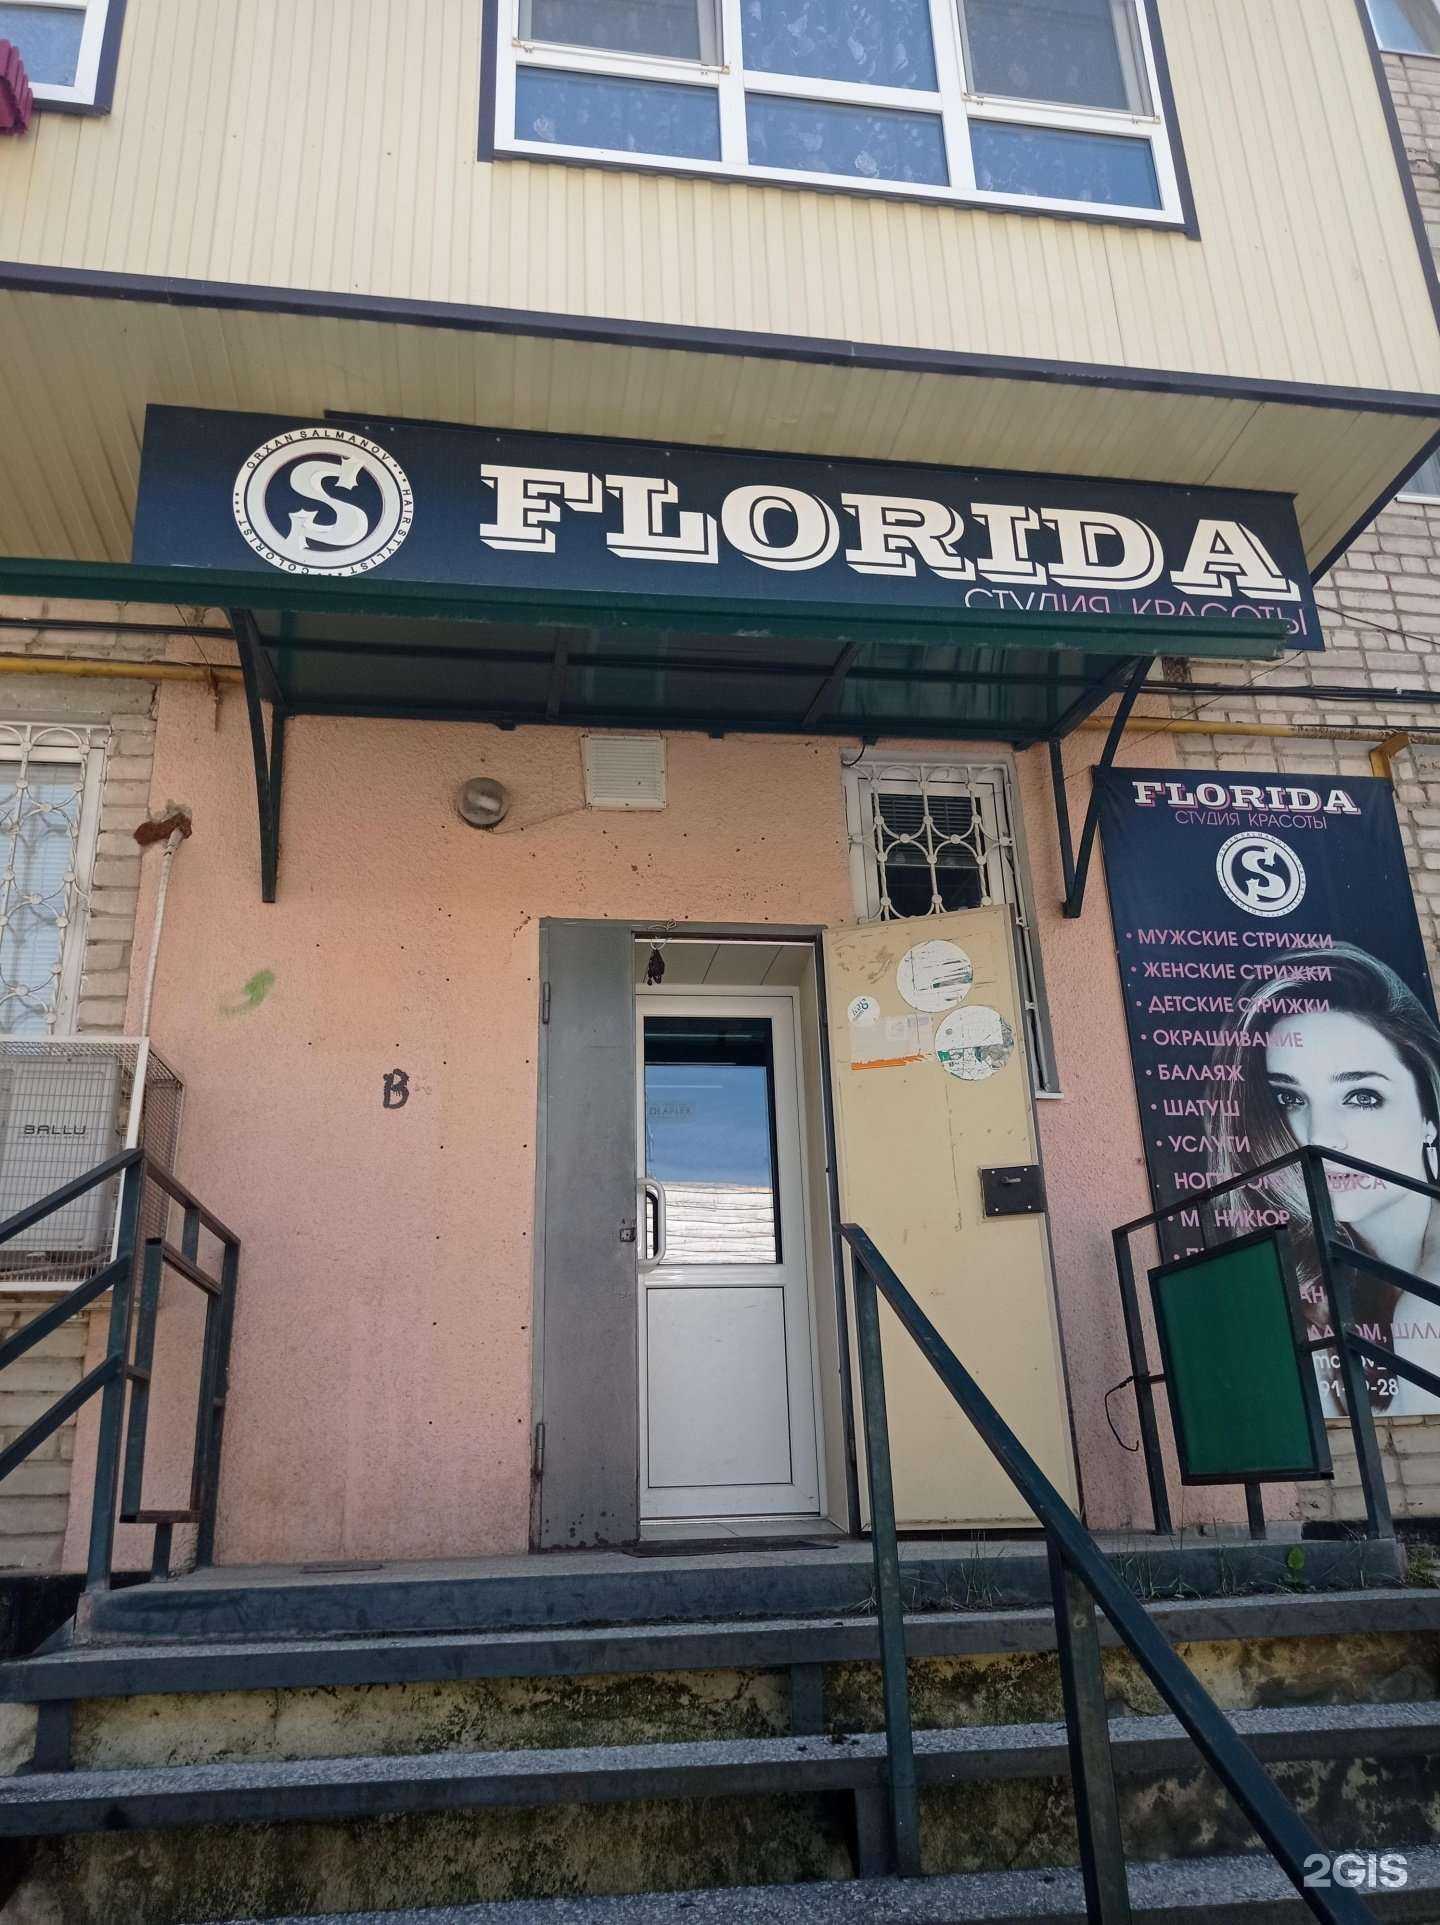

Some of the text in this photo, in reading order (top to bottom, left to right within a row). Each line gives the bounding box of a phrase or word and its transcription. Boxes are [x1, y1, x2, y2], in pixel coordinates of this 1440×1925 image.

[246, 429, 391, 469] ORXAN SALMANOV
[349, 488, 413, 574] HAIRSTYLIST
[479, 464, 1302, 602] FLORIDA
[238, 518, 310, 575] COLORIST
[1132, 780, 1362, 815] FLORIDA
[1175, 810, 1328, 830] СТУДИЯ КРАСОТЫ
[1138, 929, 1333, 949] МУЖСКИЕ СТРИЖКИ
[1143, 962, 1332, 982] ЖЕНСКИЕ СТРИЖКИ
[1148, 995, 1330, 1014] ДЕТСКИЕ СТРИЖКИ
[1153, 1029, 1304, 1047] ОКРАШИВАНИЕ
[1157, 1063, 1245, 1082] БАЛАЯЖ
[1163, 1098, 1241, 1117] ШАТУШ
[23, 1124, 88, 1136] BALLU
[1168, 1134, 1251, 1153] УСЛУГИ
[1181, 1208, 1291, 1228] МНИКЮР
